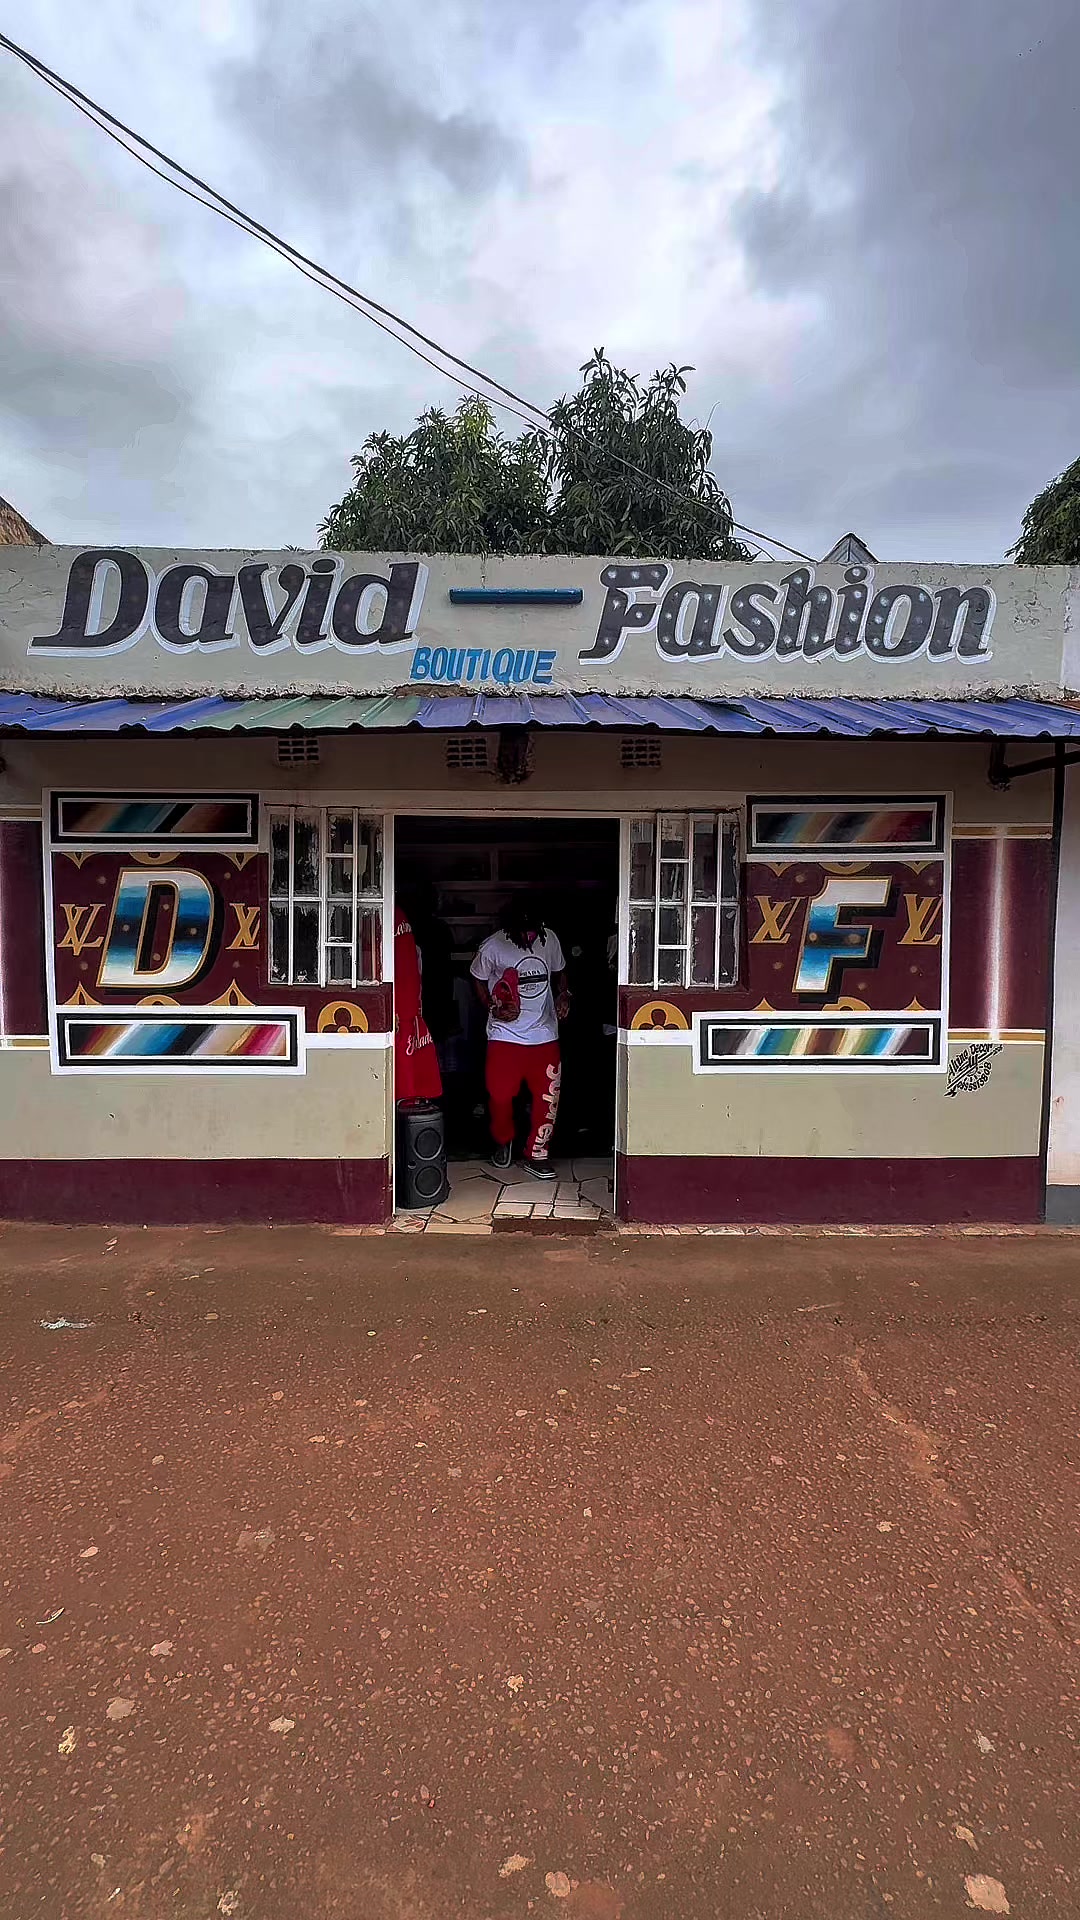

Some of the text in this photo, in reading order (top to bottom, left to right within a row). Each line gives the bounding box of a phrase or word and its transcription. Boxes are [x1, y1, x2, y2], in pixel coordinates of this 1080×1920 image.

[27, 549, 994, 664] David Fashion
[410, 646, 556, 685] BOUTIQUE
[96, 867, 217, 990] D
[791, 876, 892, 995] F
